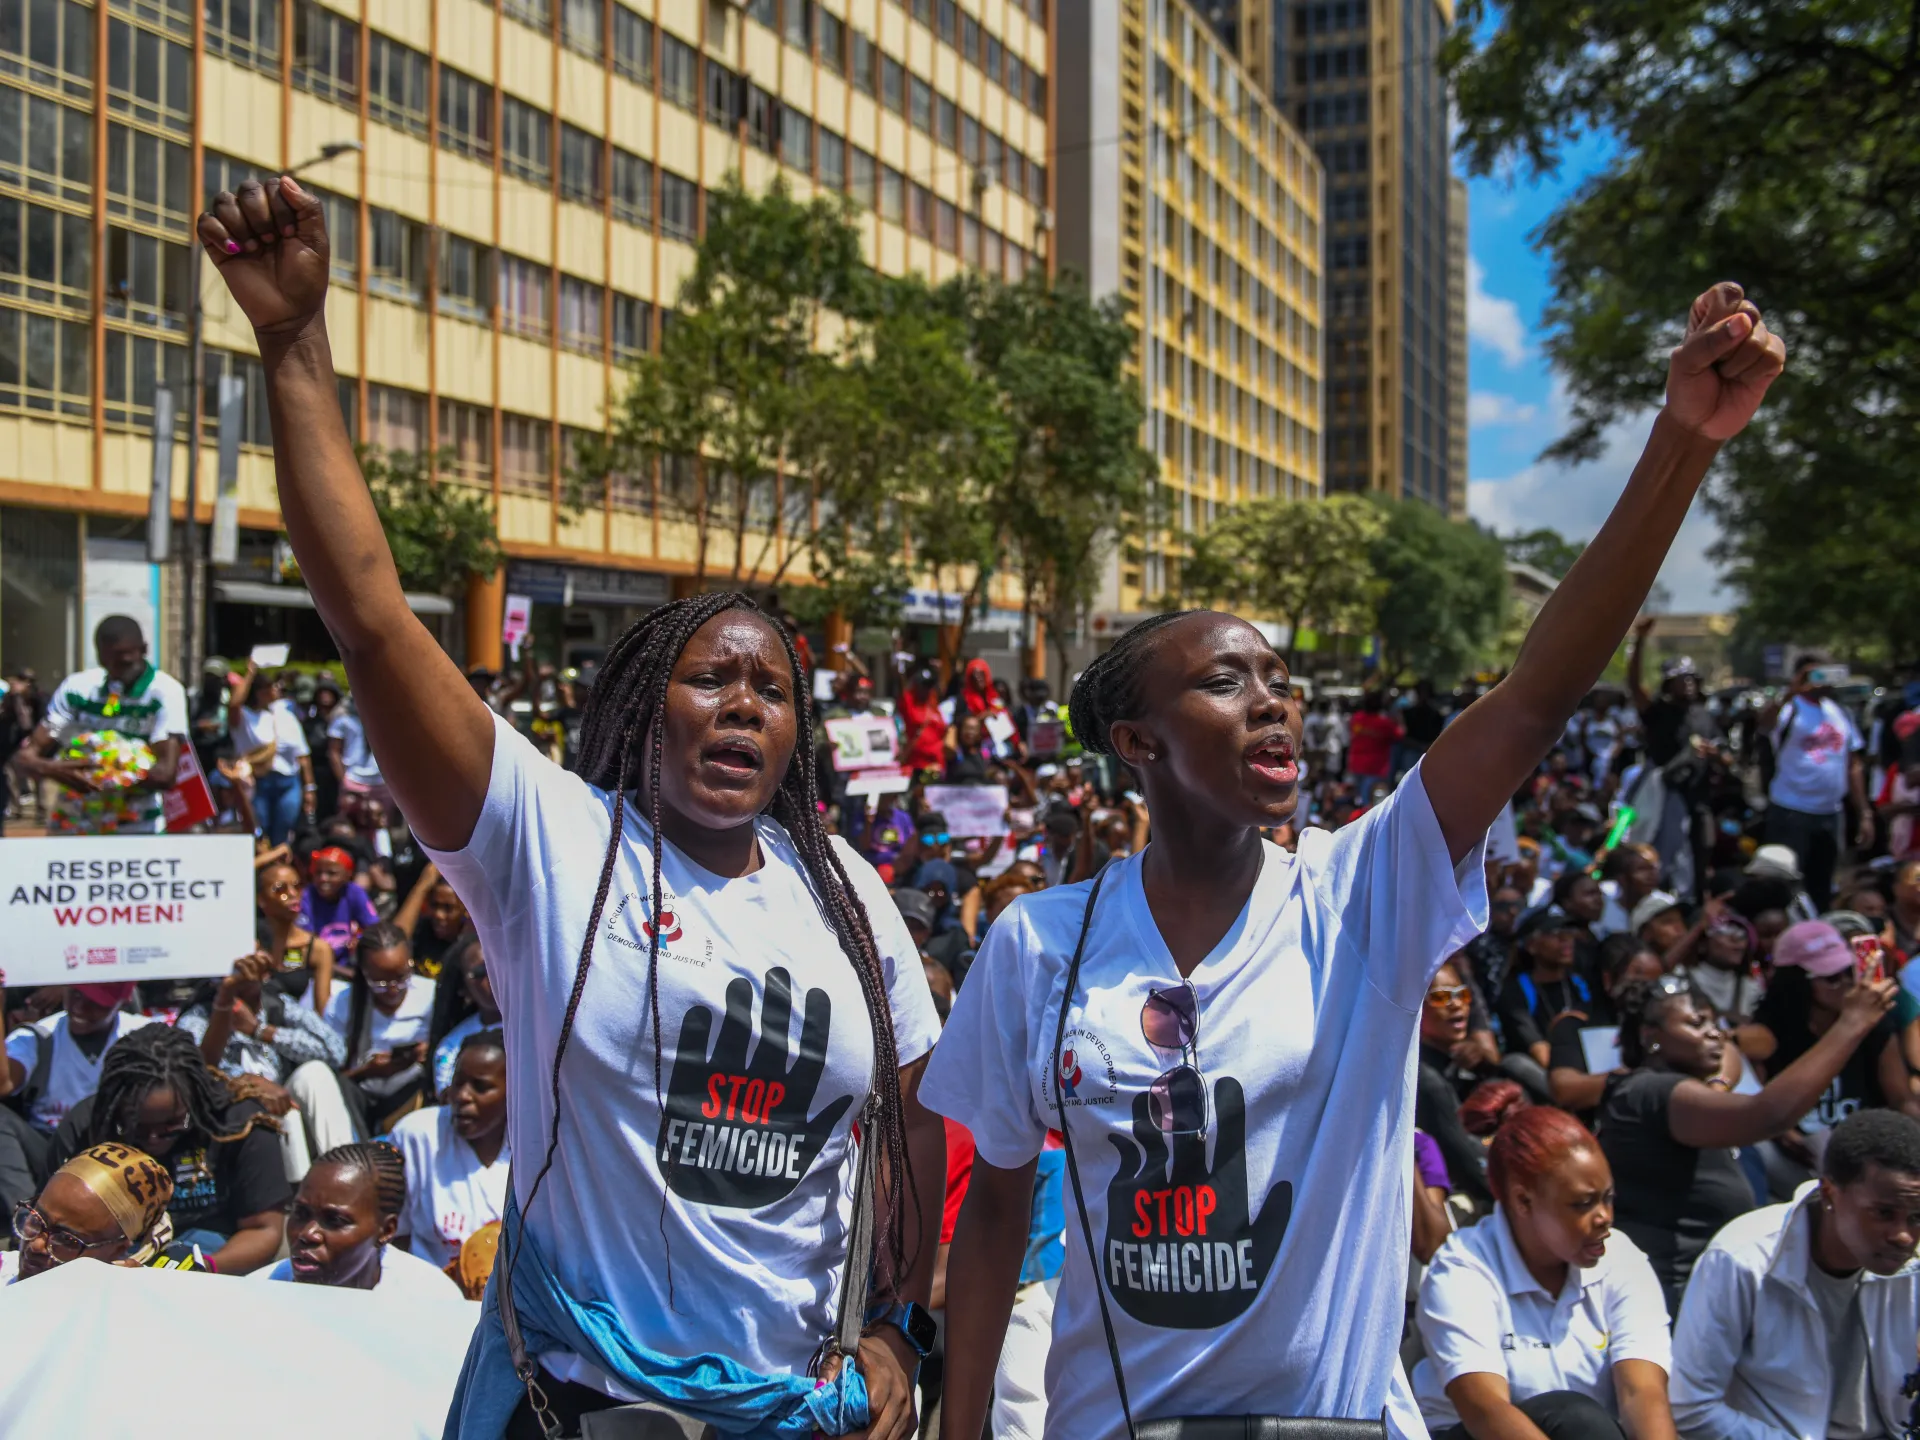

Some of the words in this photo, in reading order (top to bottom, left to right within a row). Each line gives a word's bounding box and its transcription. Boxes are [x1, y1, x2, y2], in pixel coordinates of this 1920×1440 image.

[48, 859, 181, 880] RESPECT
[10, 884, 76, 905] AND
[88, 880, 225, 903] PROTECT
[640, 893, 676, 902] WOEN
[54, 904, 184, 927] WOMEN!
[673, 954, 706, 969] JUSTICE
[1085, 1032, 1117, 1095] DEVELOPMENT
[701, 1073, 786, 1125] STOP
[1083, 1096, 1115, 1106] JUSTICE
[662, 1120, 805, 1179] FEMICIDE
[1131, 1184, 1217, 1237] STOP
[1109, 1239, 1257, 1293] FEMICIDE
